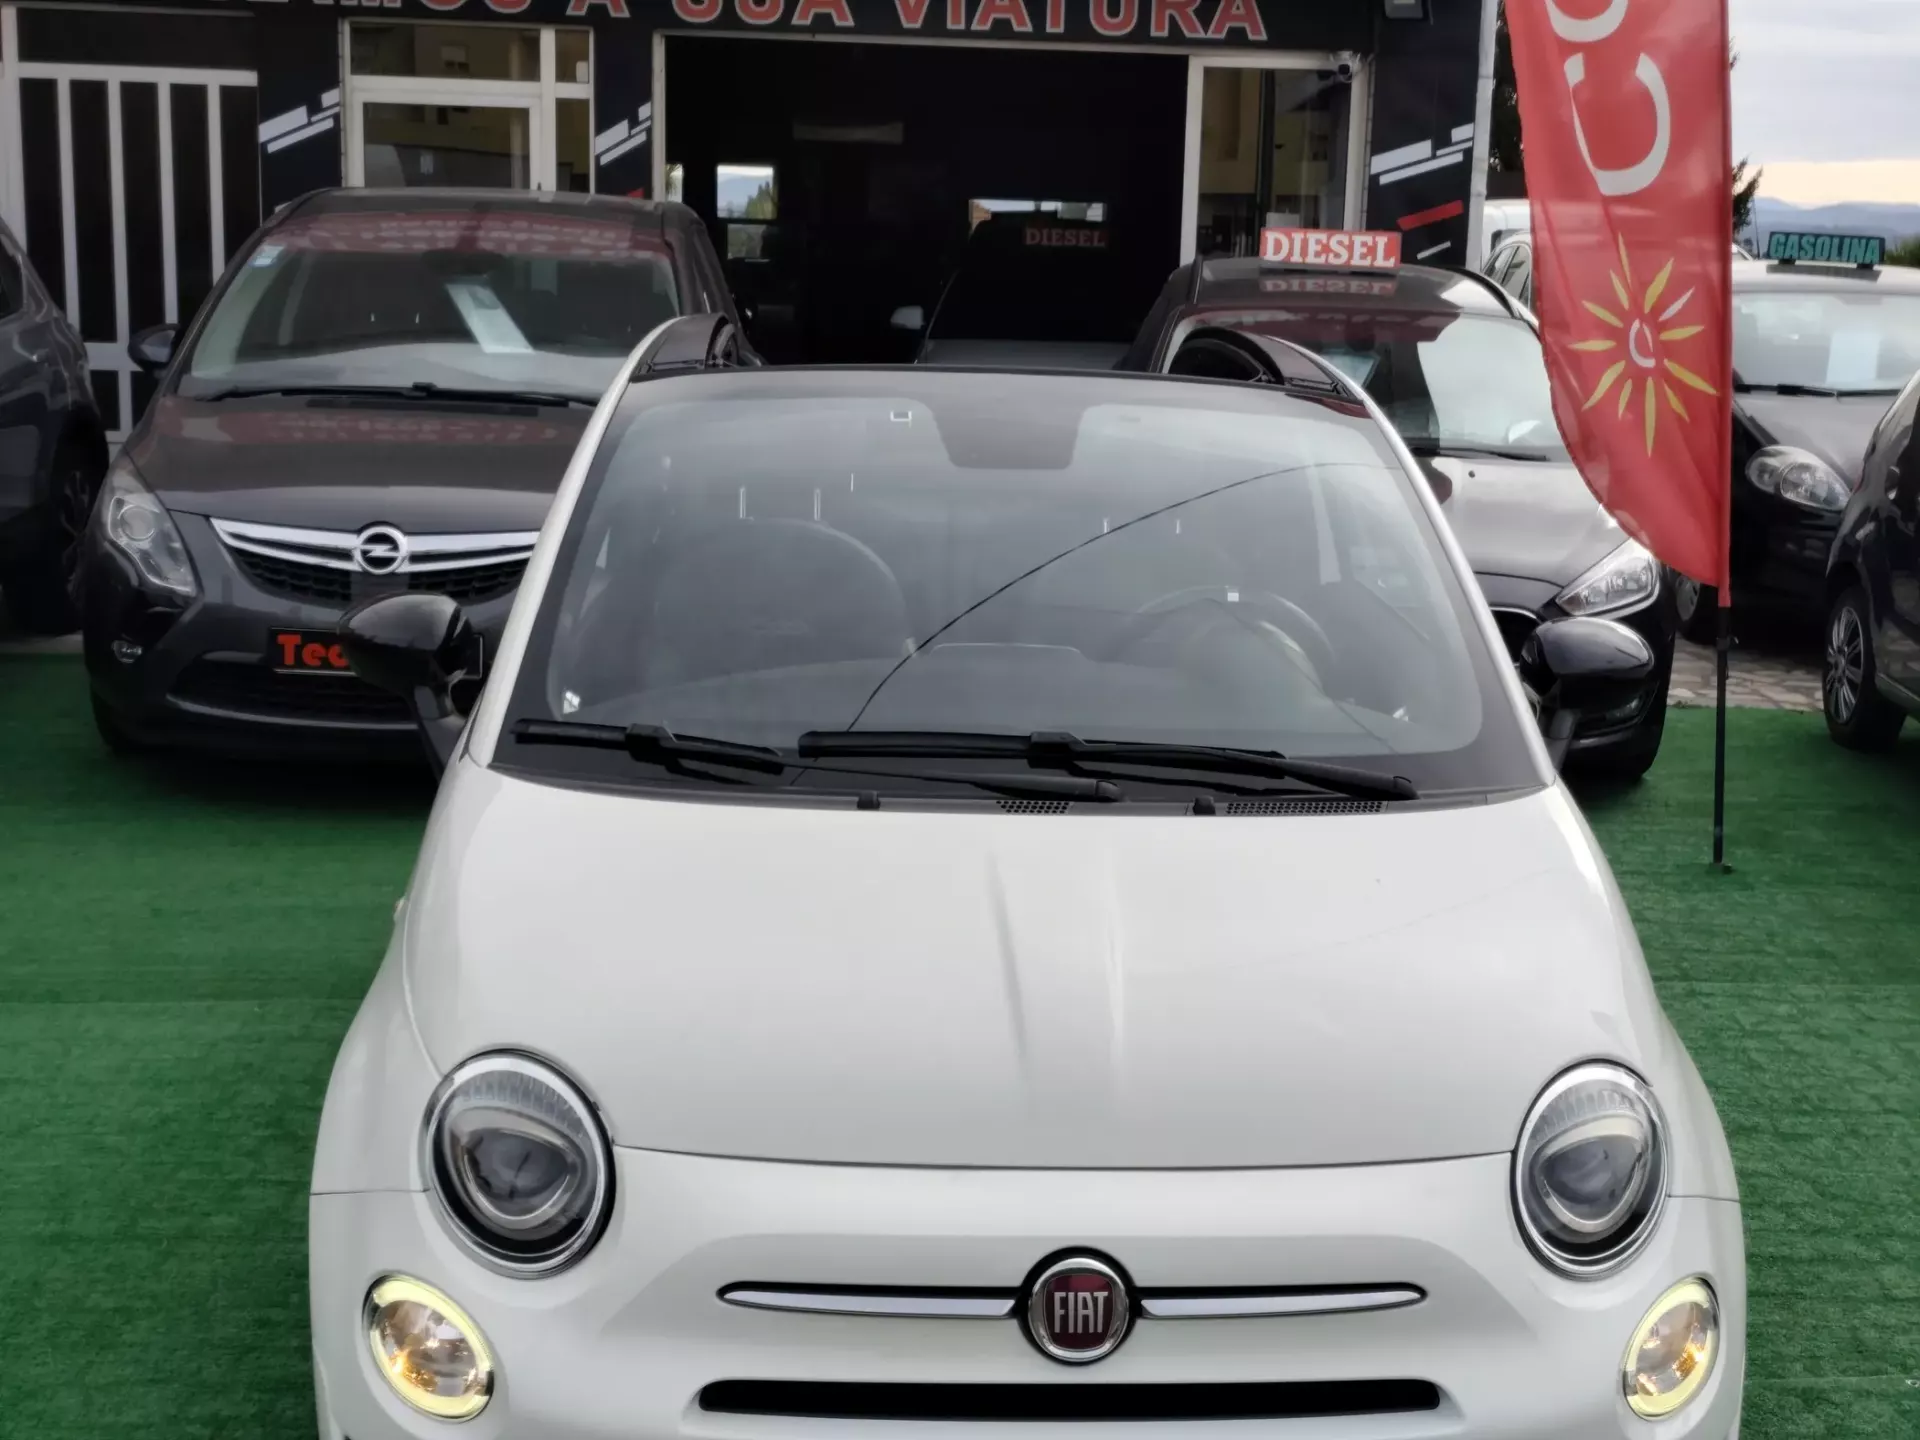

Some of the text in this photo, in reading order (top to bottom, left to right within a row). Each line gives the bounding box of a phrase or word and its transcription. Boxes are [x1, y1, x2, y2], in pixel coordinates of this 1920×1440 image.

[1025, 227, 1105, 247] DIESEL
[1263, 231, 1396, 267] DIESEL
[1769, 233, 1880, 265] GASOLINA
[1053, 1291, 1108, 1334] FIAT
